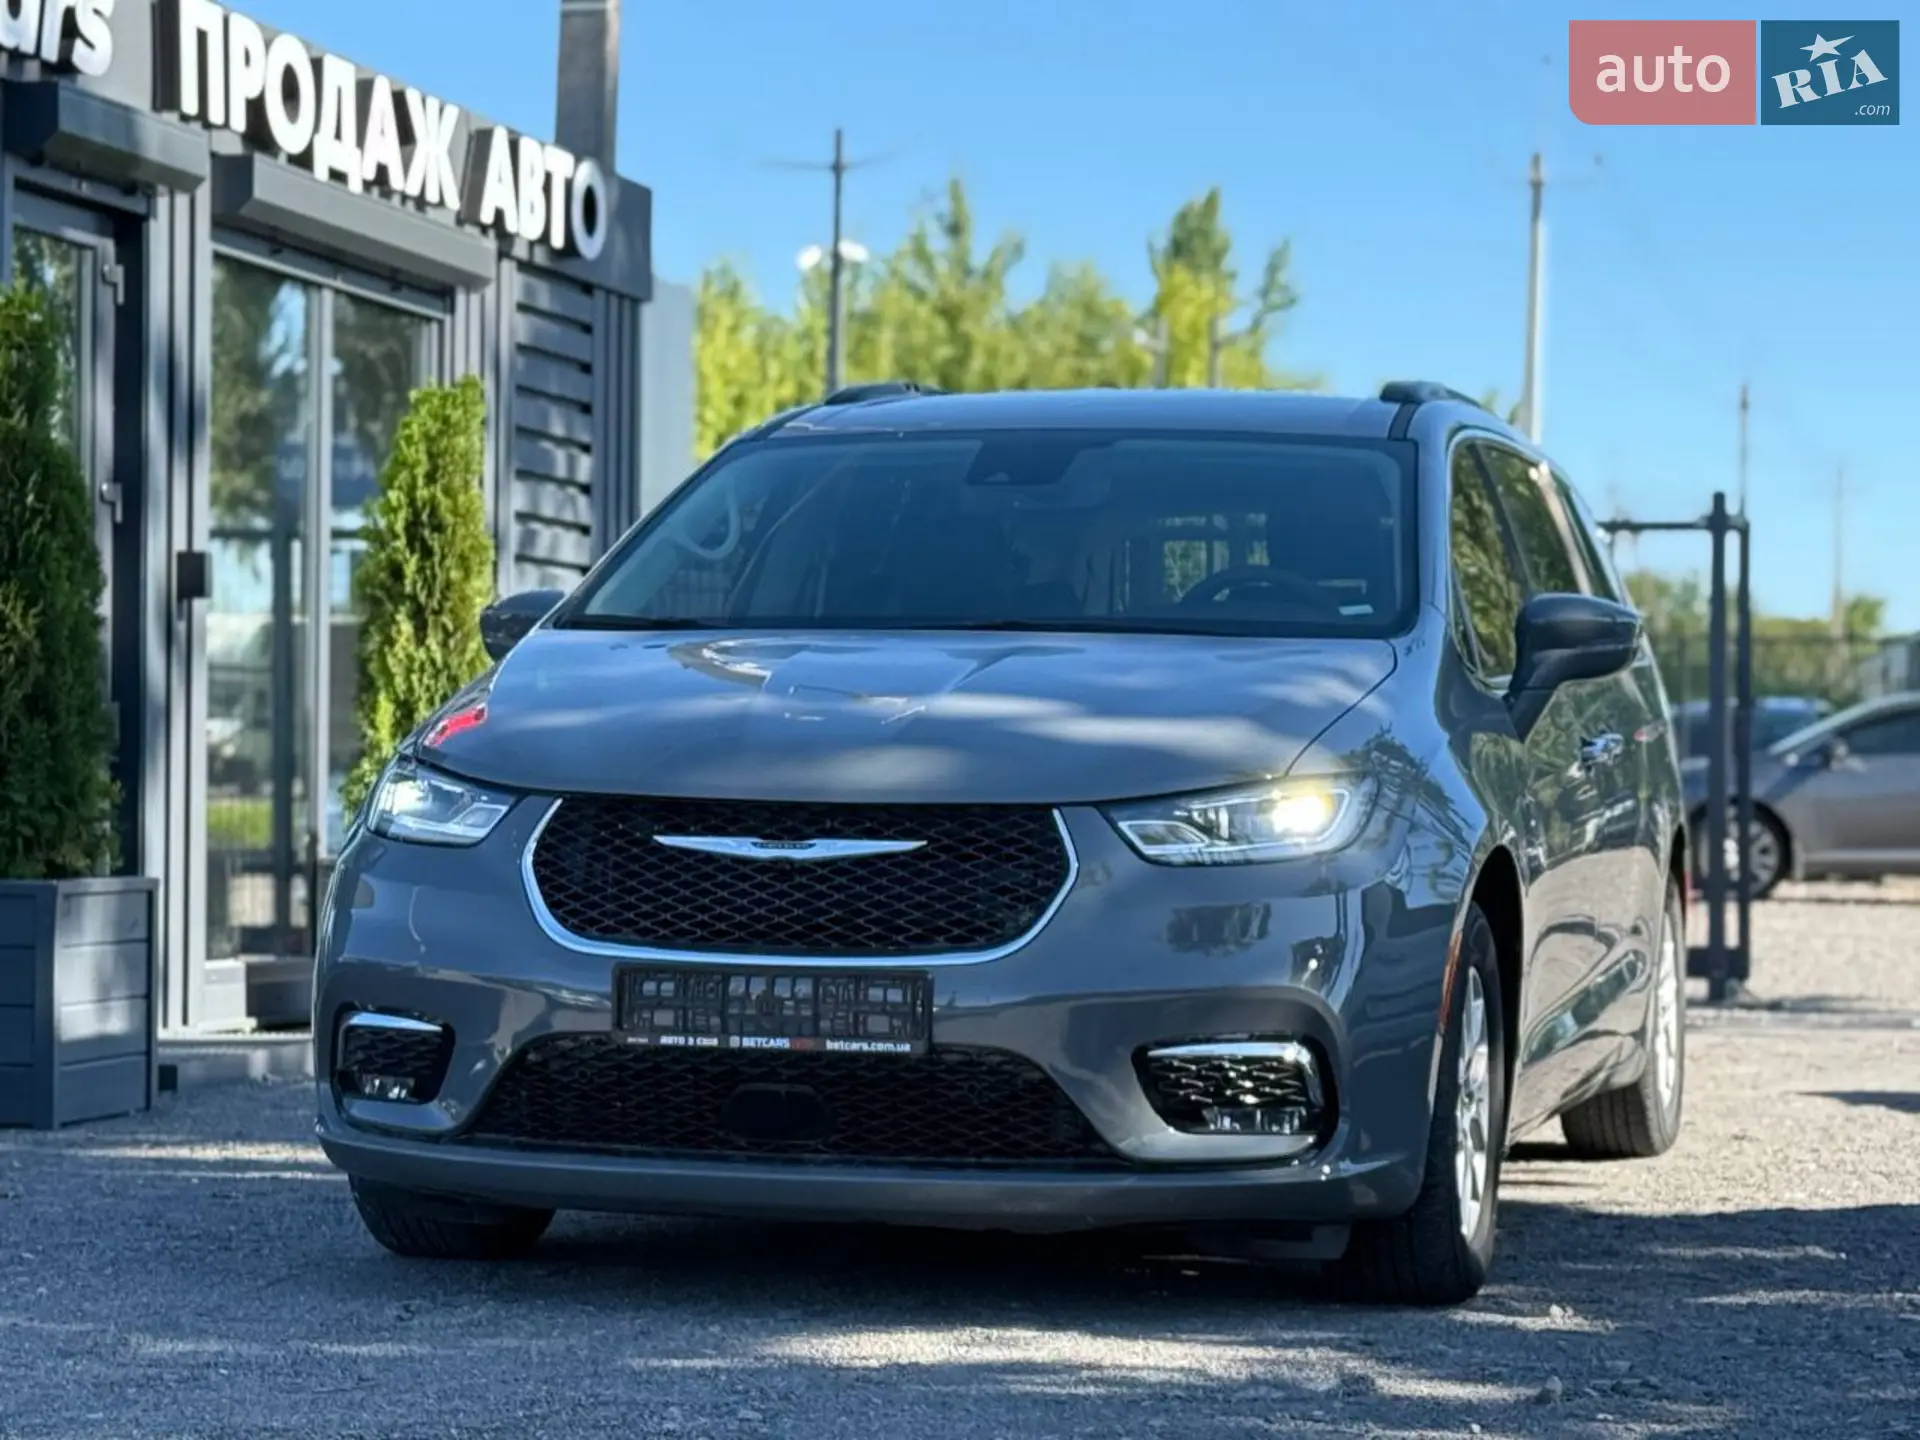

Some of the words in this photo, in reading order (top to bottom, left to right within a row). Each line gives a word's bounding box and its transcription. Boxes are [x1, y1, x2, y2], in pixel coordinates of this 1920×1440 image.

[178, 0, 461, 210] ПРОДАЖ
[480, 124, 607, 261] АВТО
[742, 1036, 791, 1049] BETCARS
[825, 1039, 911, 1053] betcars.com.ua
